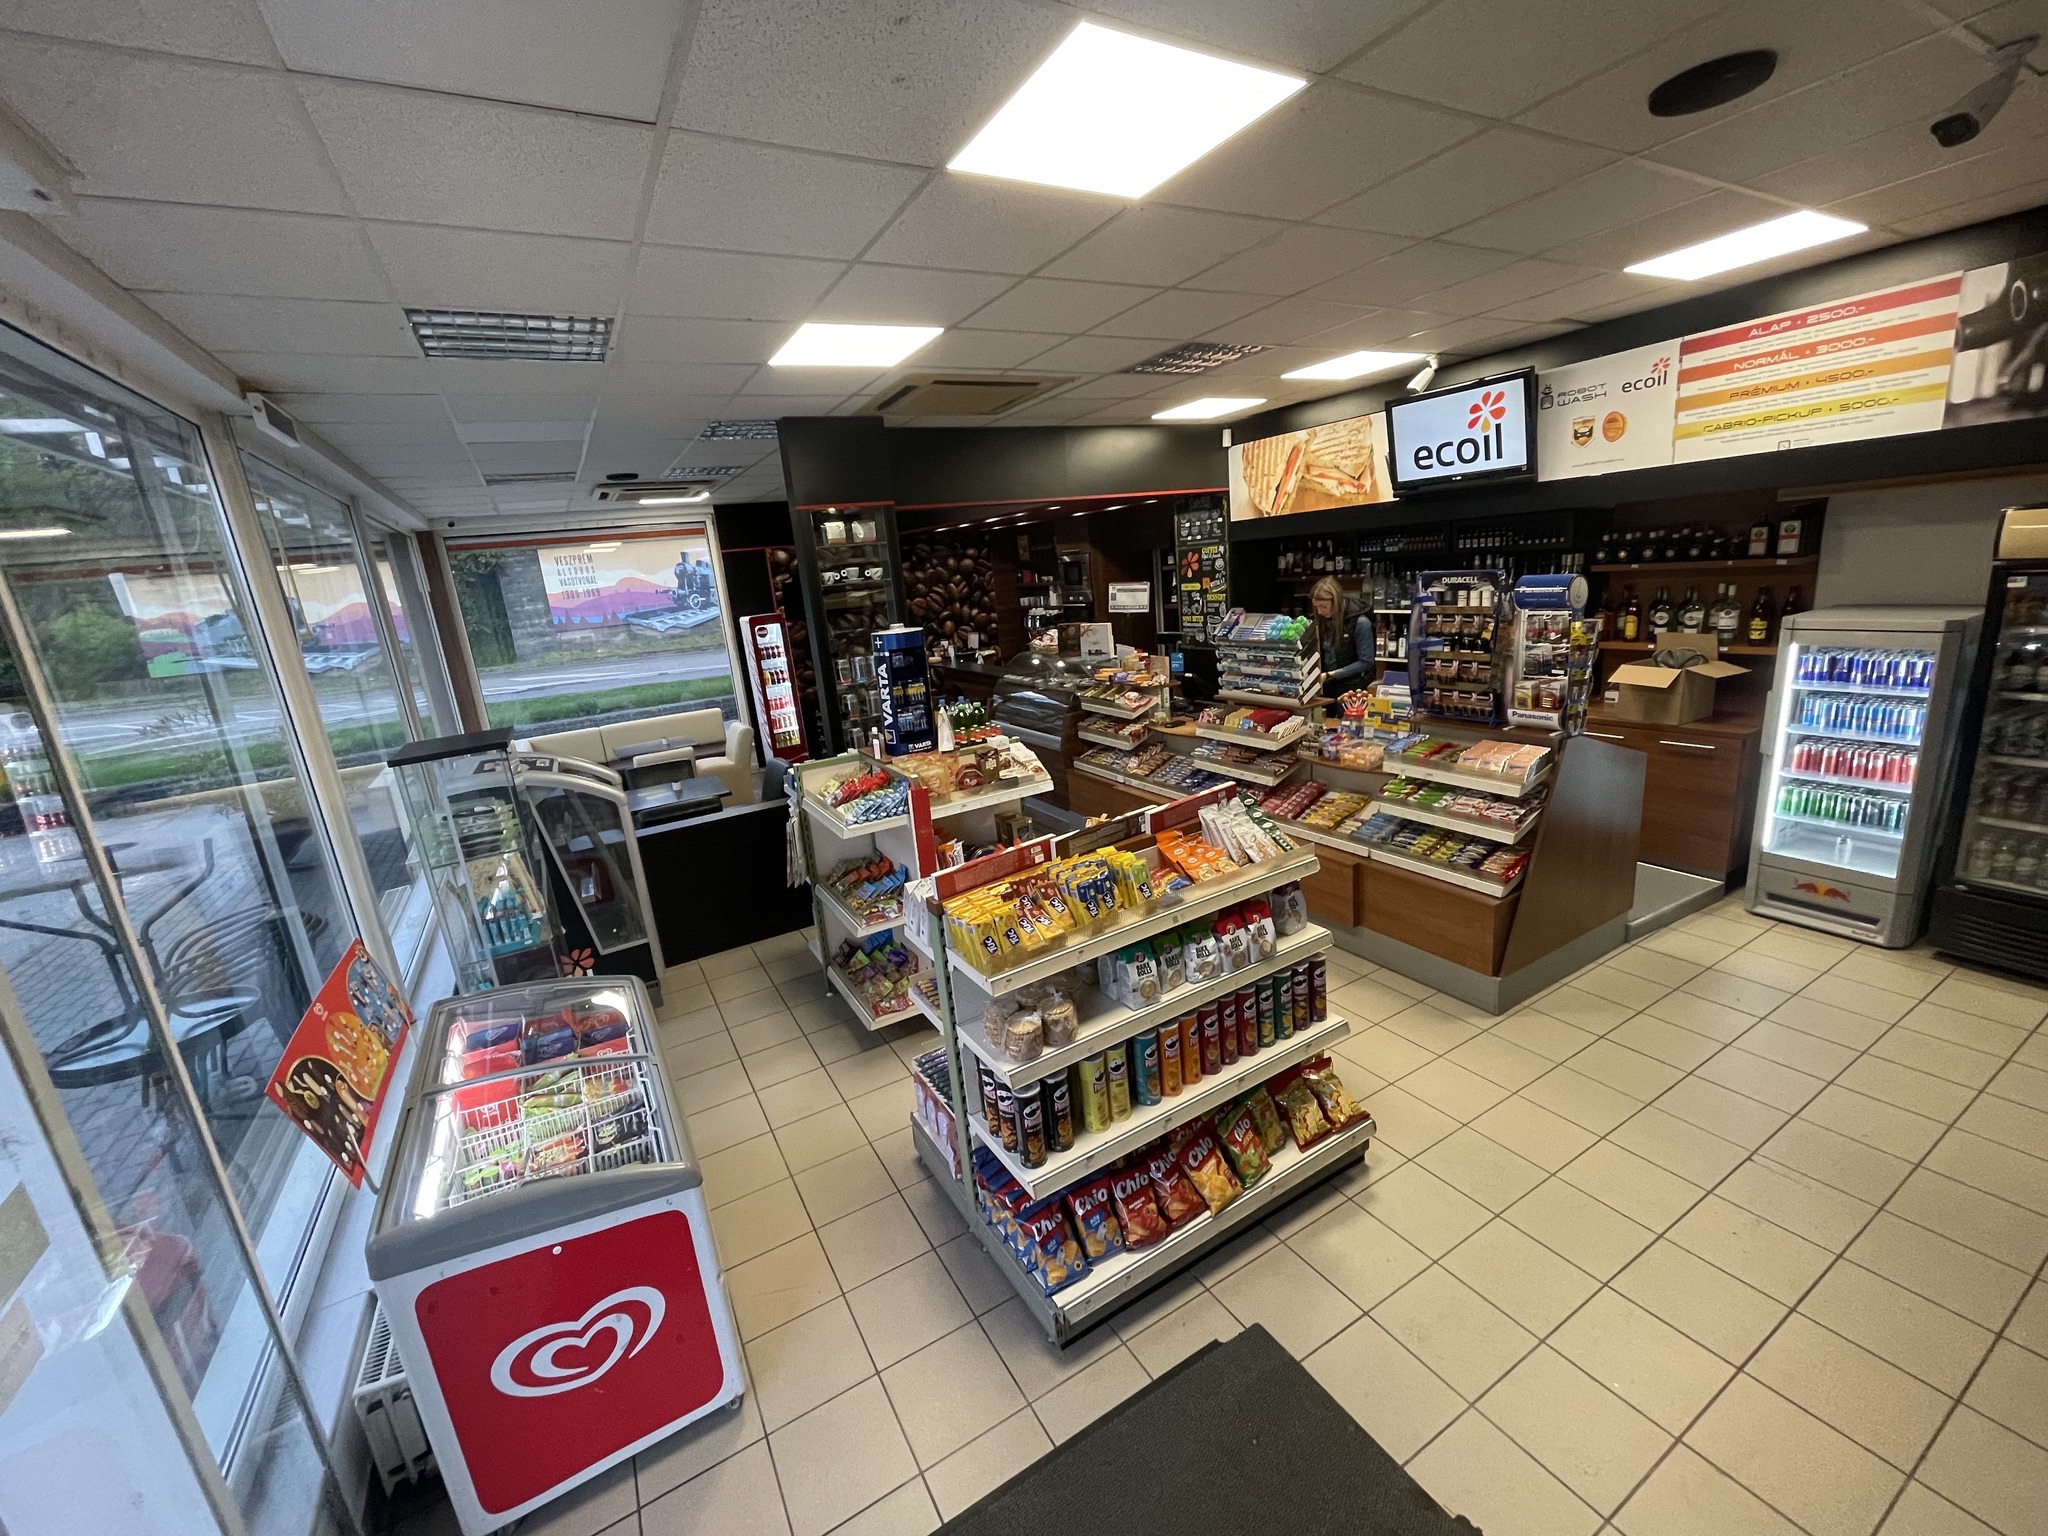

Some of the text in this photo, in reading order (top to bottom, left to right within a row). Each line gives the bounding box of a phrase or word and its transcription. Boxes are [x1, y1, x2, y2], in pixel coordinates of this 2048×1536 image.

[1748, 320, 1792, 338] ALAP
[1806, 305, 1866, 324] 2500.-
[1734, 350, 1800, 371] NORMÁL
[1815, 336, 1876, 354] 3000.-
[1557, 382, 1607, 398] ROBOT
[1622, 370, 1668, 393] ecoil
[1730, 380, 1800, 400] PRÉMIUM
[1816, 368, 1874, 384] 4500.-
[1557, 391, 1607, 407] WASH
[1703, 407, 1822, 433] CABRIO-PICKUP
[1413, 422, 1504, 470] ecoil
[878, 663, 894, 726] VARTA
[1512, 710, 1554, 722] Panasonic
[914, 740, 932, 749] VARTA
[1104, 893, 1114, 908] TUC
[1141, 883, 1152, 899] TUC
[1051, 898, 1065, 913] TUC
[1088, 901, 1098, 917] TUC
[1020, 918, 1034, 934] TUC
[985, 937, 998, 953] TUC
[1008, 929, 1019, 945] TUC
[1136, 962, 1151, 970] BAKE
[1137, 967, 1152, 977] ROLLS
[1234, 1118, 1250, 1141] Chio
[1188, 1136, 1213, 1168] Chio
[1150, 1151, 1177, 1178] Chio
[1116, 1172, 1150, 1199] Chio
[1075, 1188, 1108, 1216] Chio
[1032, 1213, 1063, 1242] Chio
